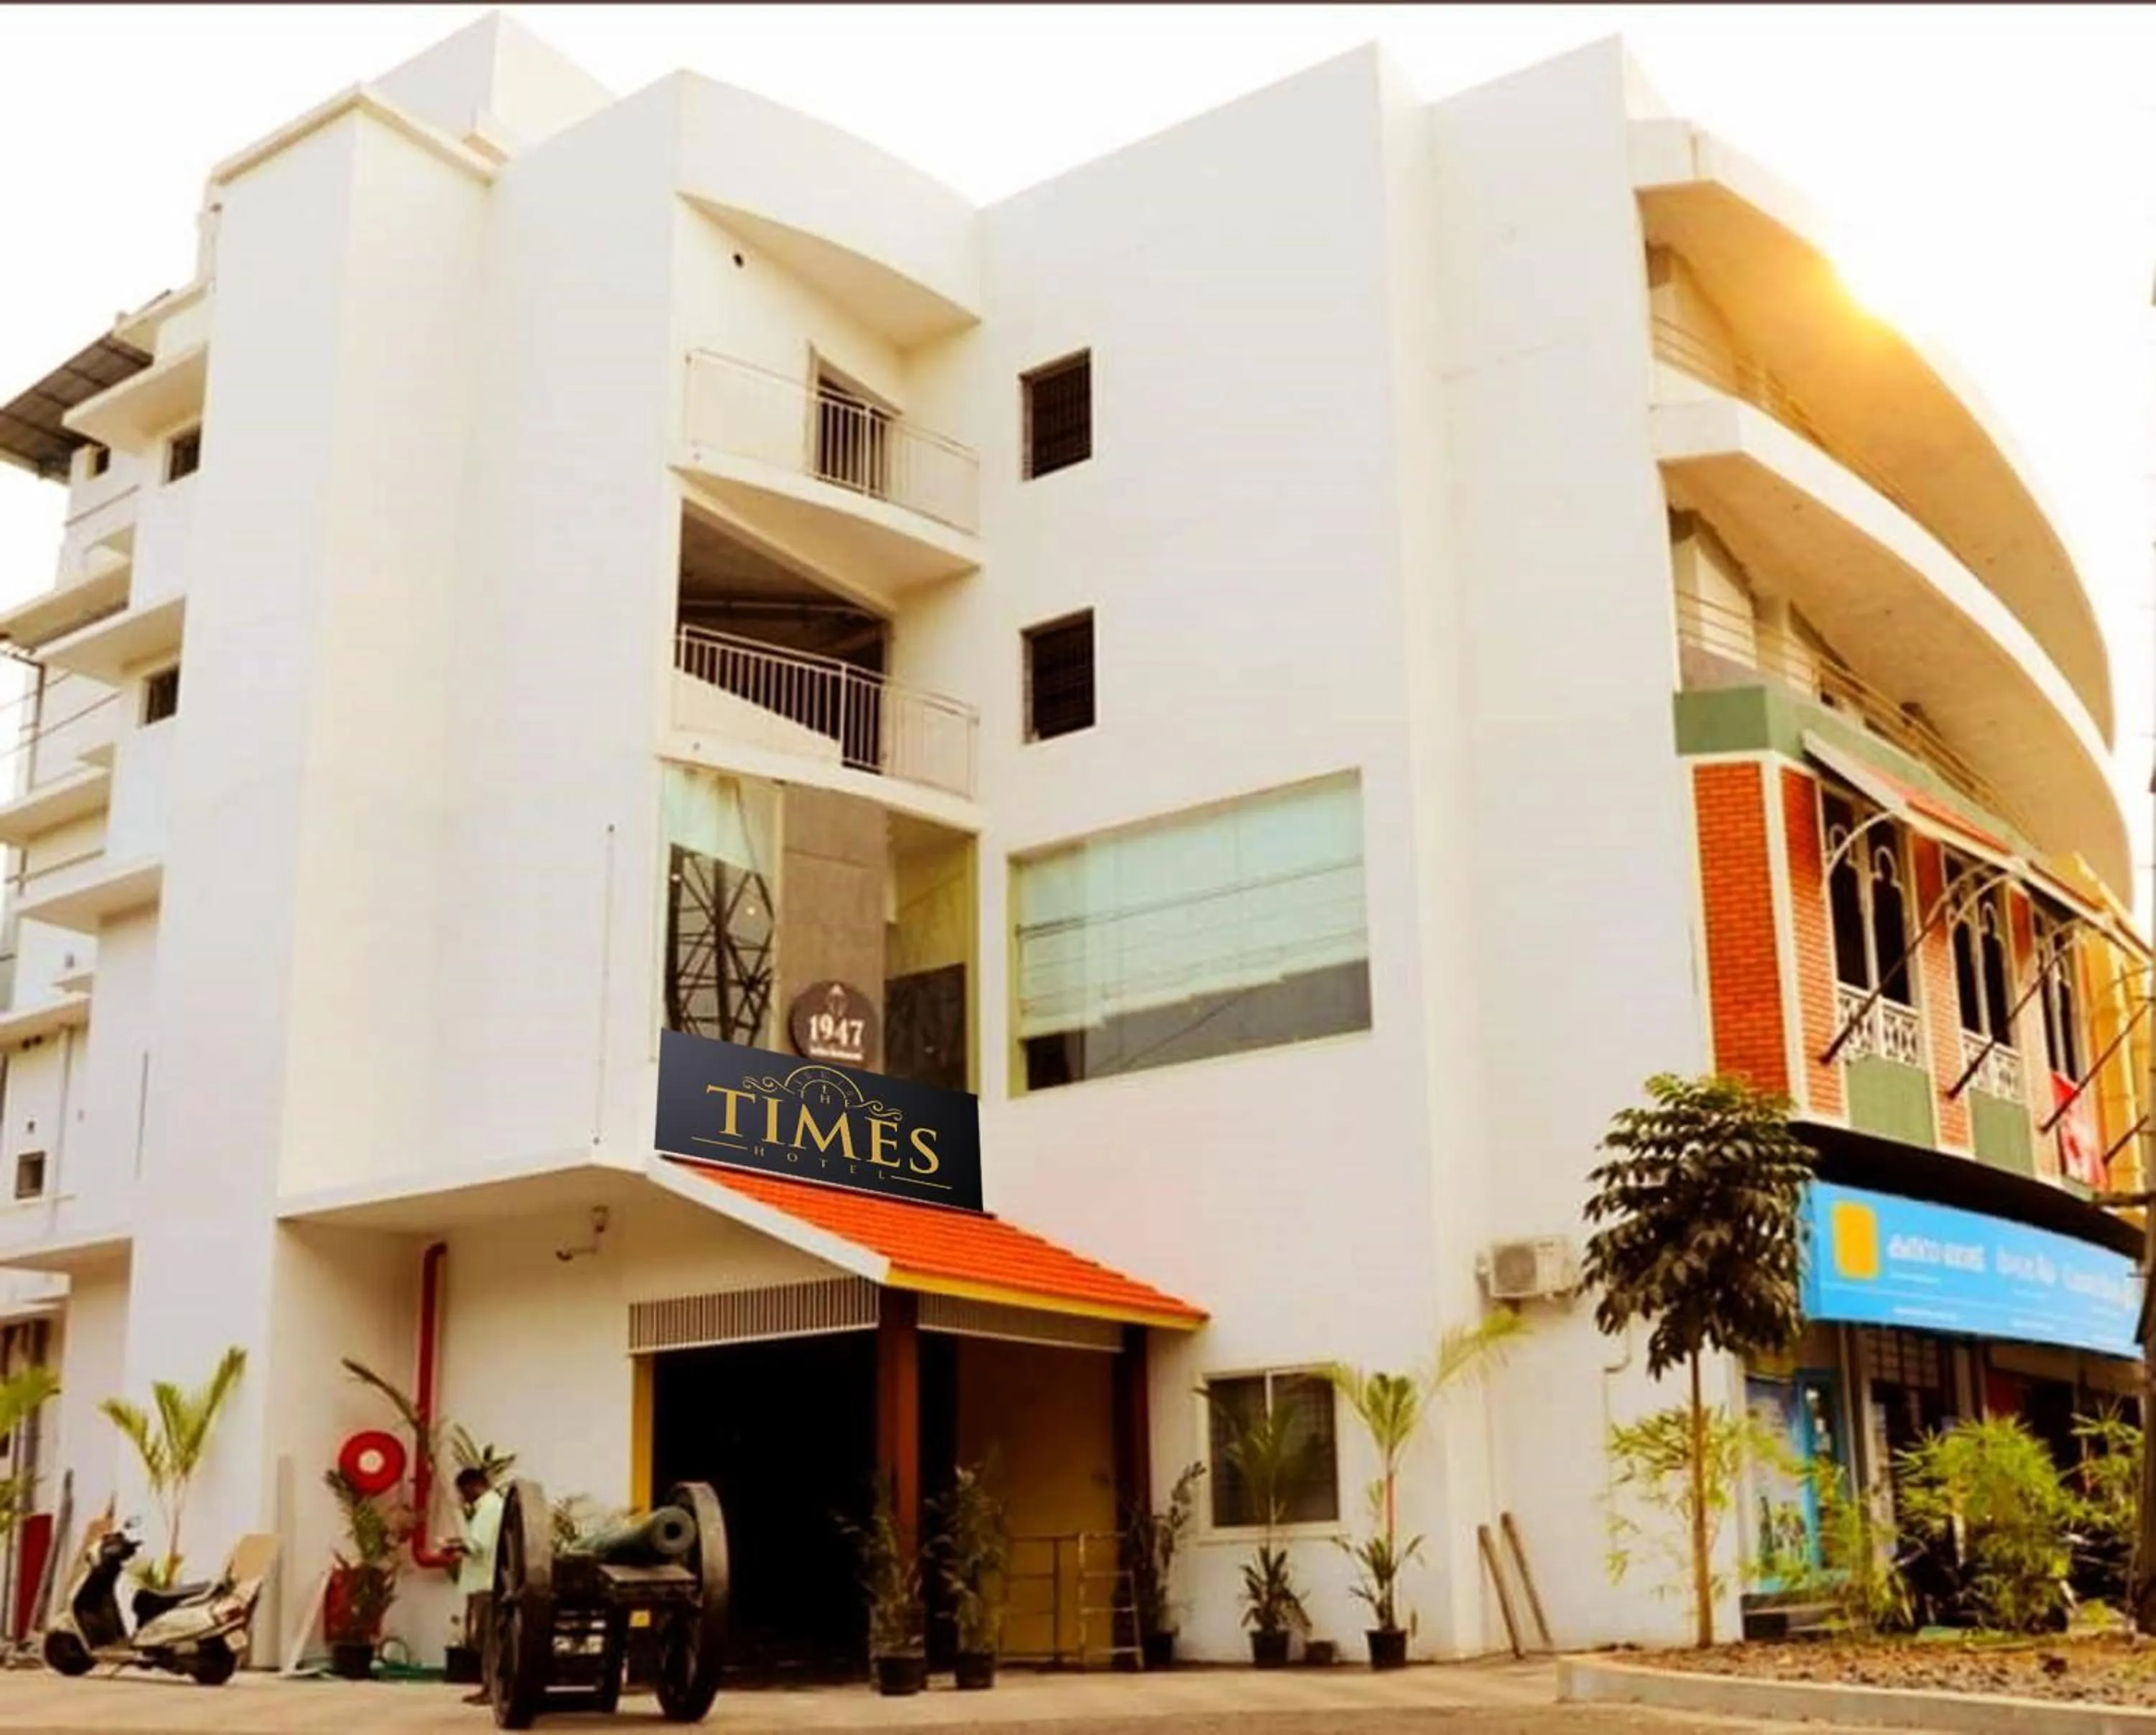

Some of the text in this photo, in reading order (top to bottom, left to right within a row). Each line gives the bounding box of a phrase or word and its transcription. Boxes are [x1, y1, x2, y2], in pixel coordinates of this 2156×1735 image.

[809, 1013, 865, 1047] 1947
[706, 1084, 940, 1174] TIMES
[754, 1145, 885, 1180] HOTEL
